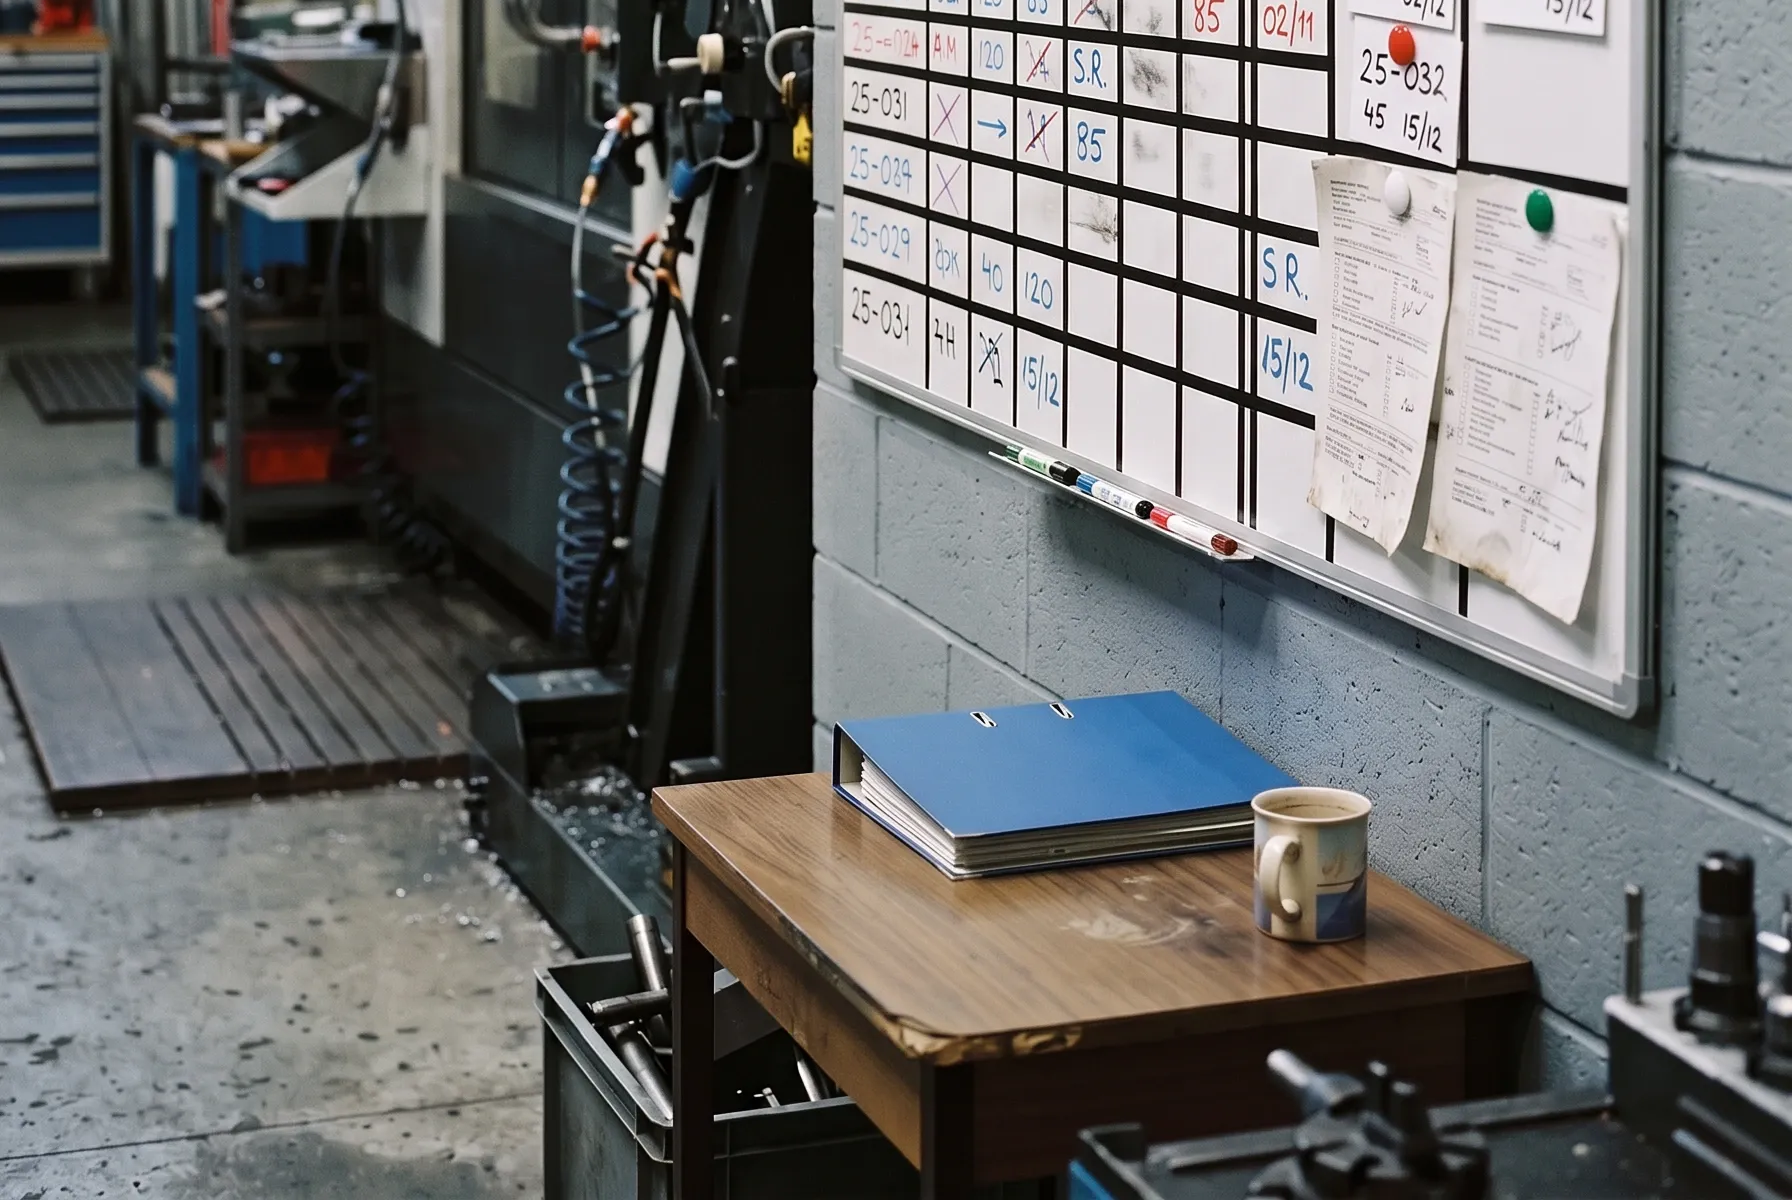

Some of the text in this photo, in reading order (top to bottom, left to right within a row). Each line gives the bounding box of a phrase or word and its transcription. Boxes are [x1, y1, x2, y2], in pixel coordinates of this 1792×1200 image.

[1263, 0, 1314, 48] 02/11
[979, 39, 1004, 71] 120
[1073, 48, 1108, 89] S.R.
[1359, 48, 1448, 102] 25-032
[851, 80, 907, 122] 25-031
[1076, 120, 1107, 163] 85
[1363, 98, 1443, 153] 45 15/12
[849, 211, 911, 262] 25-029
[981, 252, 1004, 293] 40
[1023, 271, 1053, 310] 120
[1022, 354, 1061, 410] 15/12
[1261, 333, 1314, 395] 15/12
